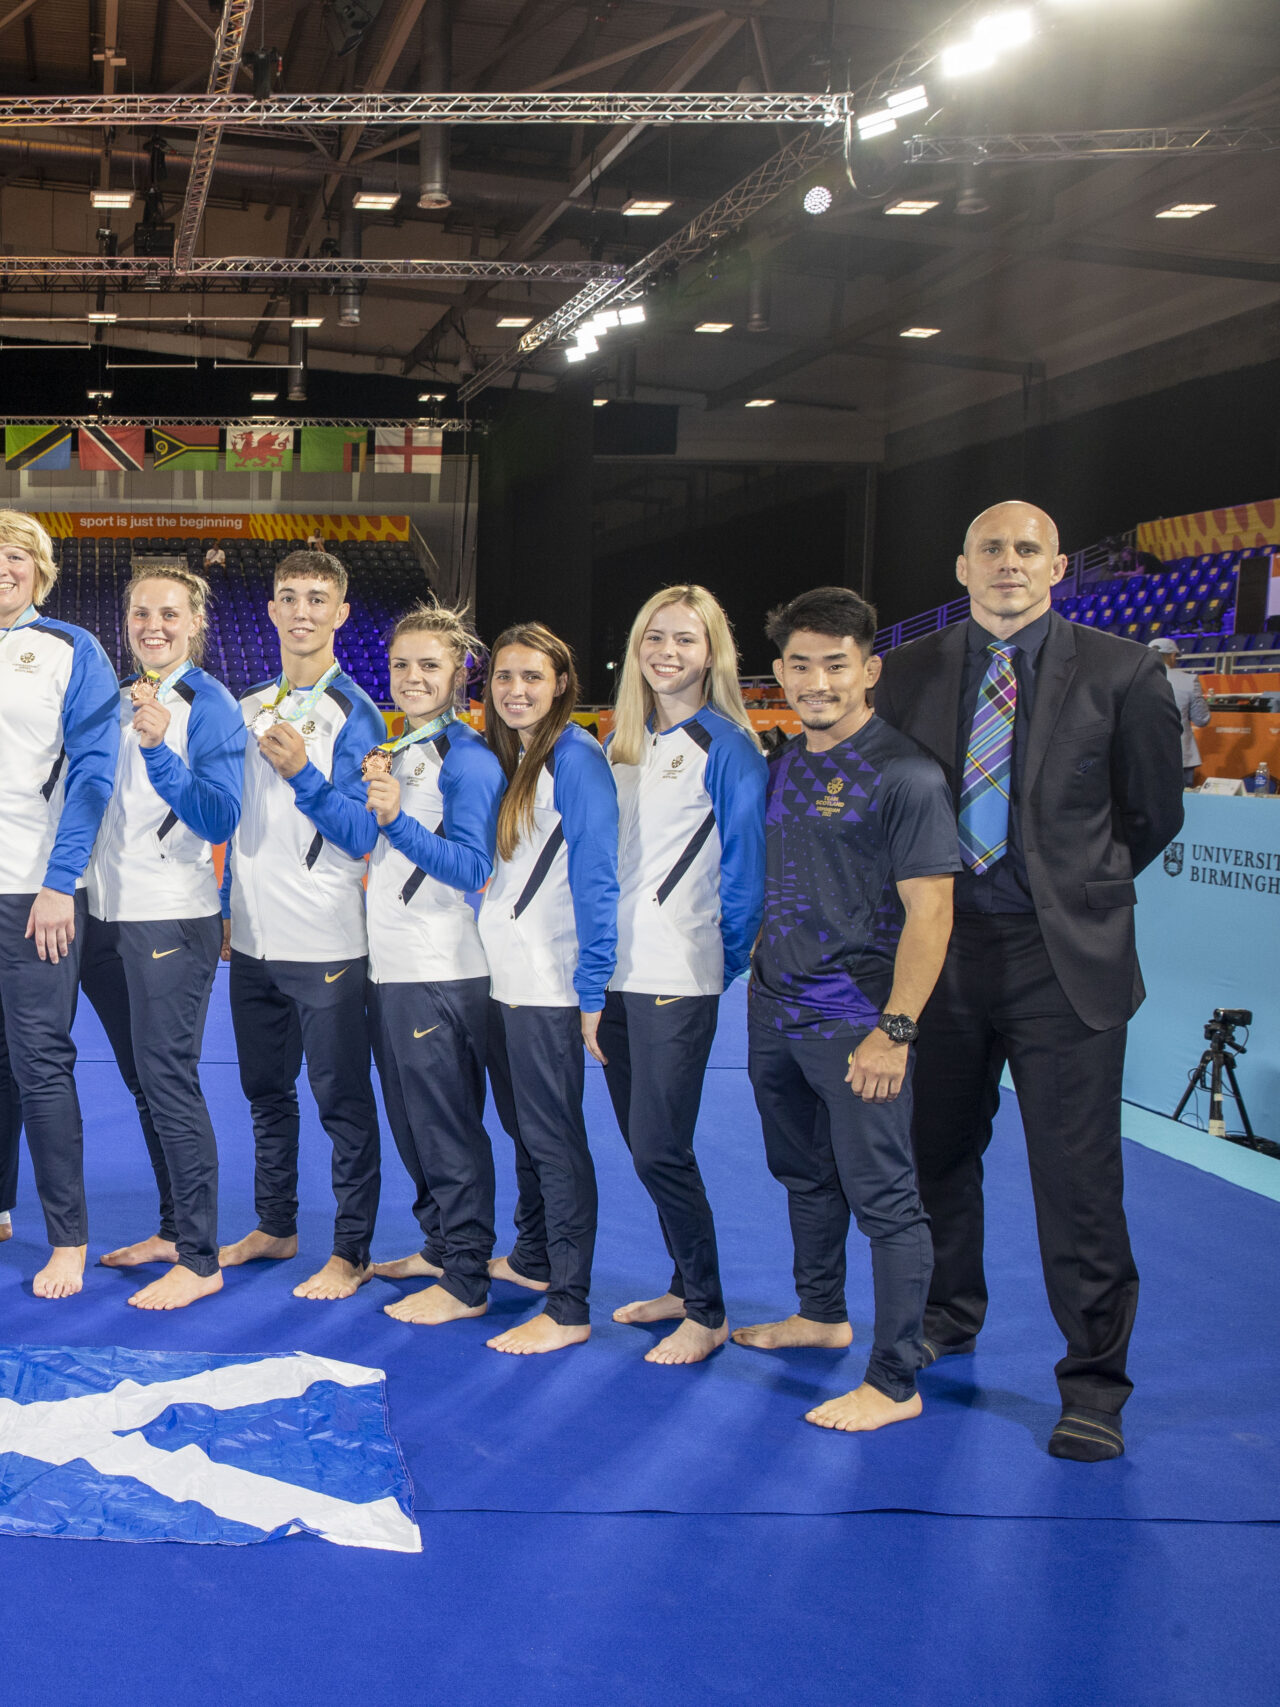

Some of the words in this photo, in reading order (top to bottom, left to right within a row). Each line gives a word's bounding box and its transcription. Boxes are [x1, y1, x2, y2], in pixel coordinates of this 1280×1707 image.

[79, 516, 114, 529] sport
[117, 515, 127, 527] is
[129, 515, 153, 529] just
[156, 516, 177, 527] the
[180, 516, 243, 530] beginning
